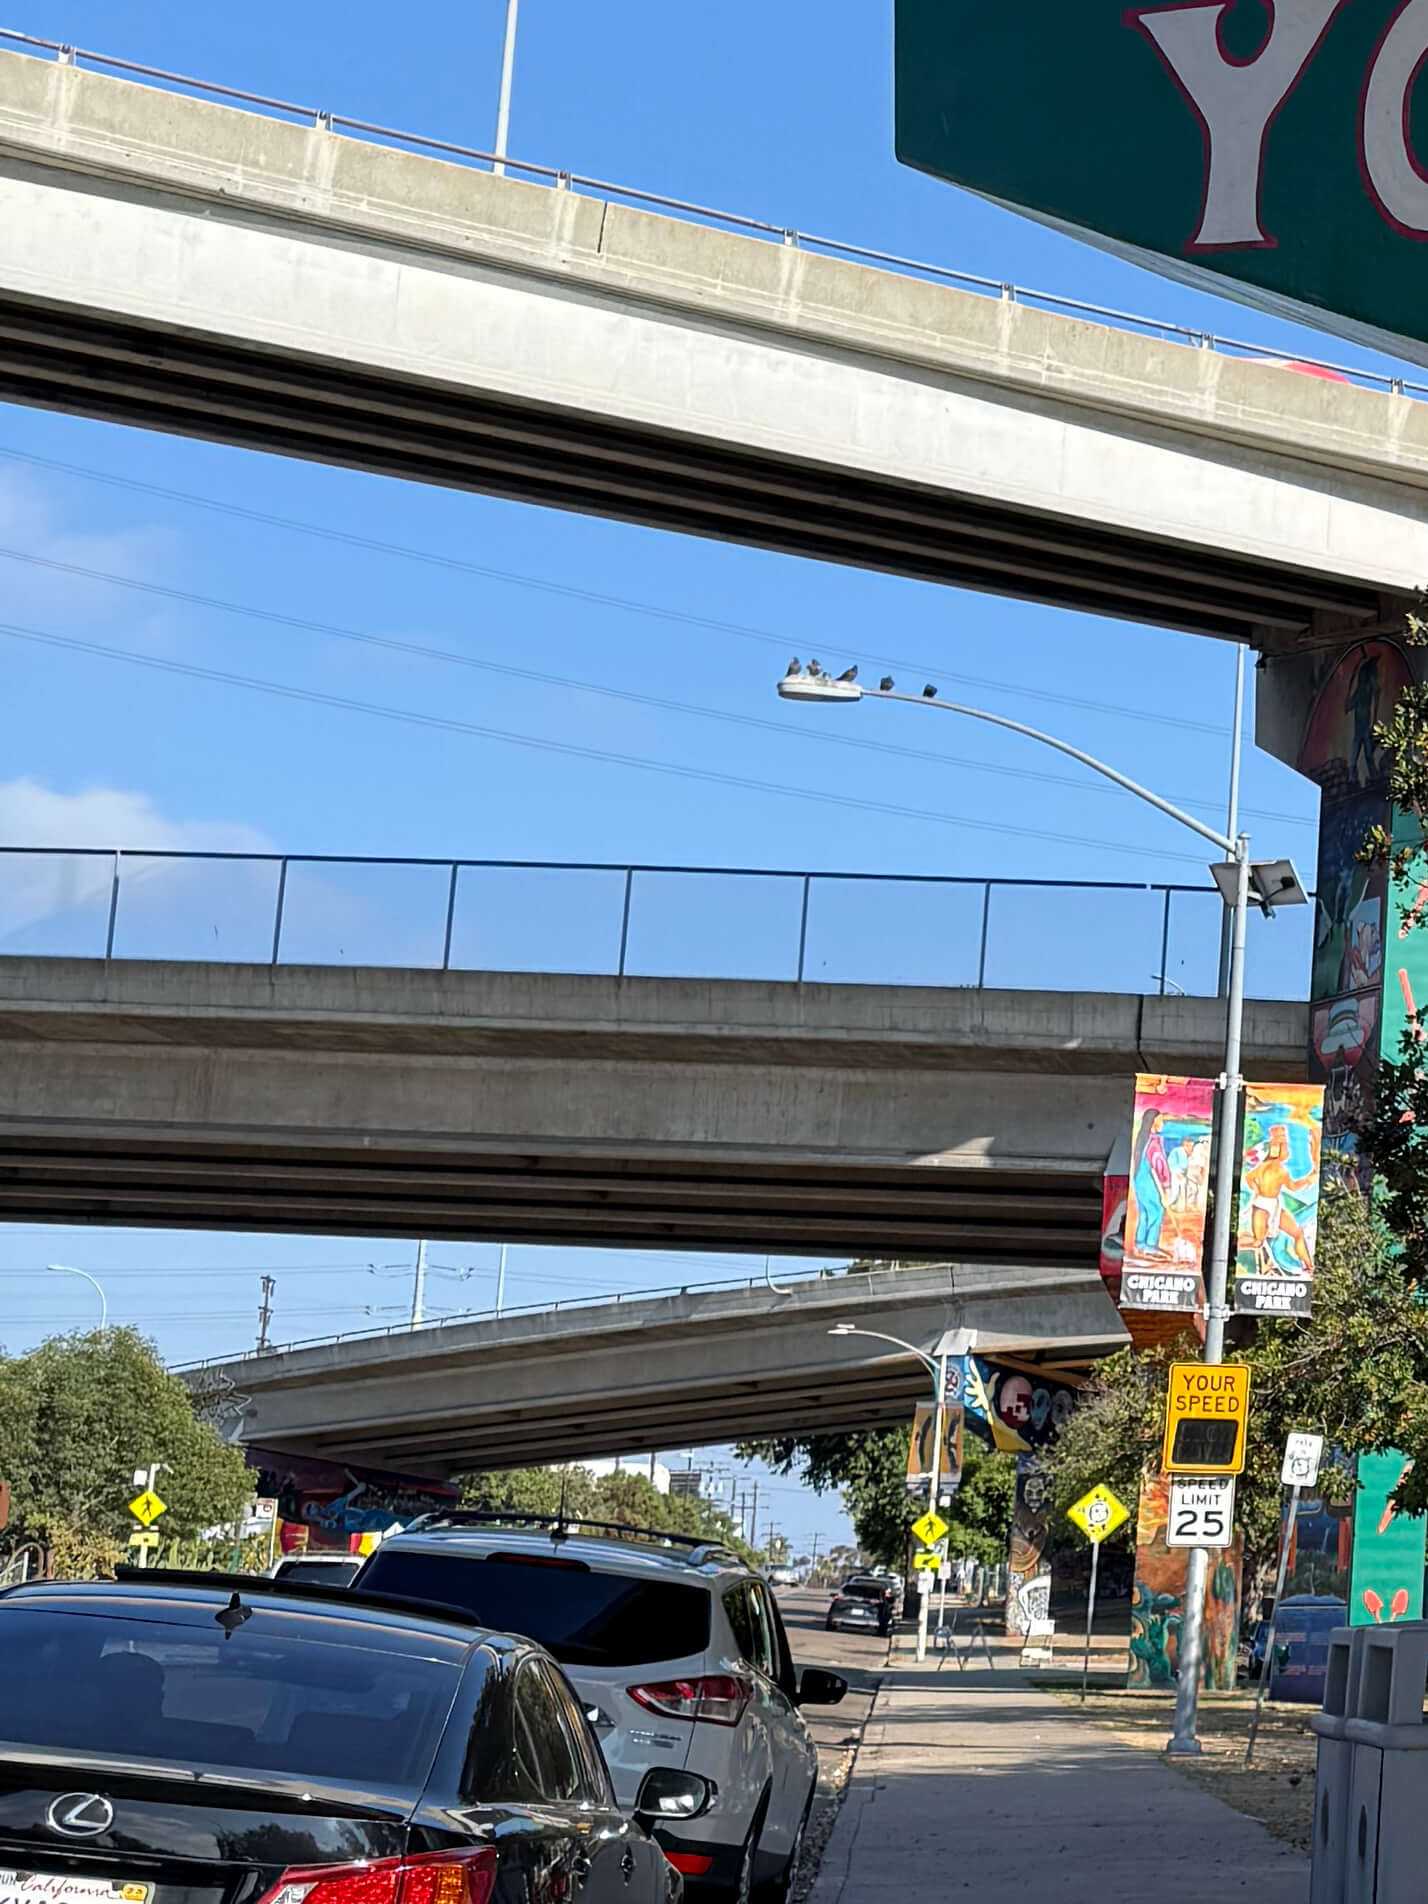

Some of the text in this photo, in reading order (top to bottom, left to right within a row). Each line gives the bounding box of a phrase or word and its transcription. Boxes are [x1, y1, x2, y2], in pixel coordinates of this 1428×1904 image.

[1127, 1275, 1195, 1292] CHICANO
[1240, 1280, 1307, 1298] CHICANO
[1142, 1289, 1180, 1304] PARK
[1255, 1296, 1292, 1310] PARK
[1183, 1374, 1235, 1393] YOUR
[1175, 1395, 1240, 1413] SPEED
[1176, 1478, 1229, 1491] SPEED
[1181, 1494, 1221, 1506] LIMIT
[1175, 1510, 1224, 1537] 25
[0, 1871, 17, 1886] UN
[21, 1875, 110, 1899] California
